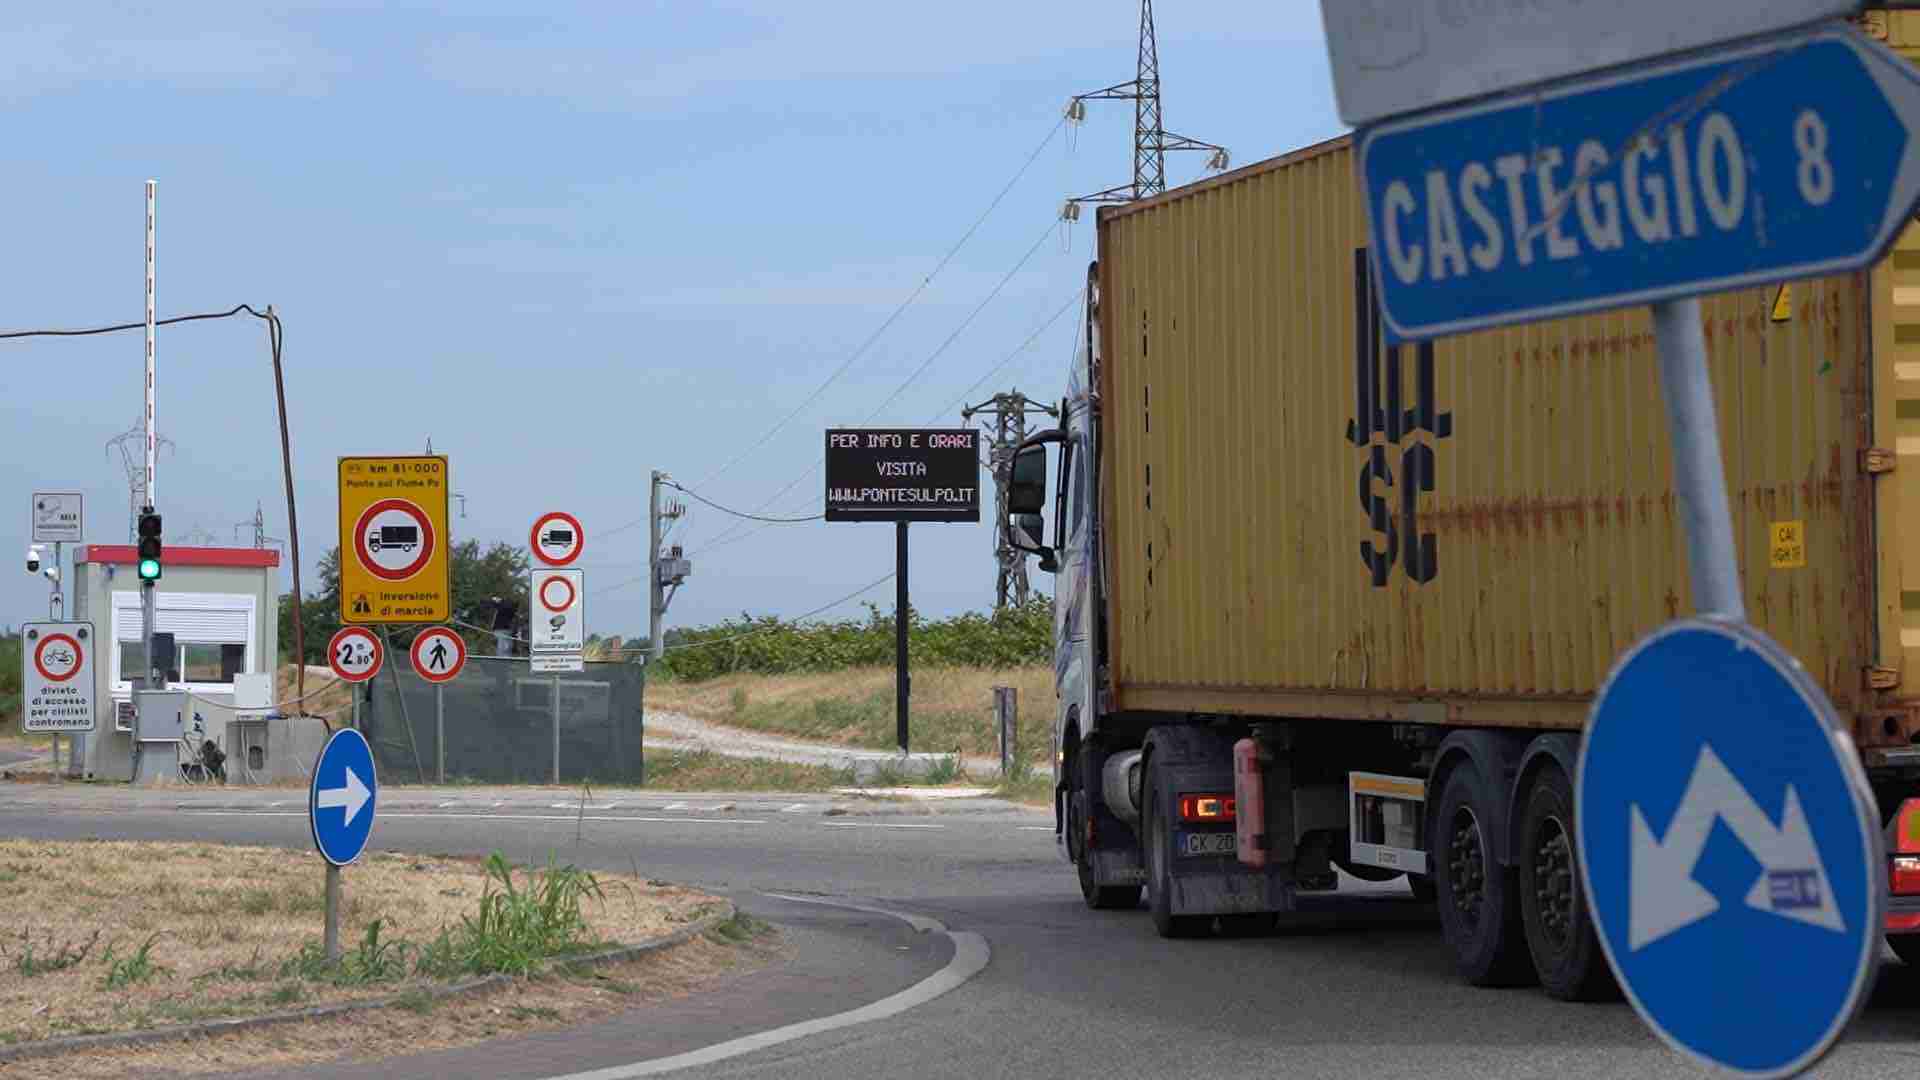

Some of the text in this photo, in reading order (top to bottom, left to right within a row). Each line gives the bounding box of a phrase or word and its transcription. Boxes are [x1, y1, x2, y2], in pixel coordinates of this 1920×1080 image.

[1383, 109, 1834, 285] CASTEGGIO 8
[830, 434, 972, 448] PER INFO E ORARI
[369, 464, 388, 473] km
[876, 461, 928, 476] VISITA
[828, 487, 974, 502] WWW.PONTESULPO.IT
[379, 605, 434, 616] di marcia
[40, 687, 78, 695] divieto
[32, 696, 88, 706] di accesso
[31, 707, 88, 718] per ciclisti
[29, 718, 90, 727] contromano
